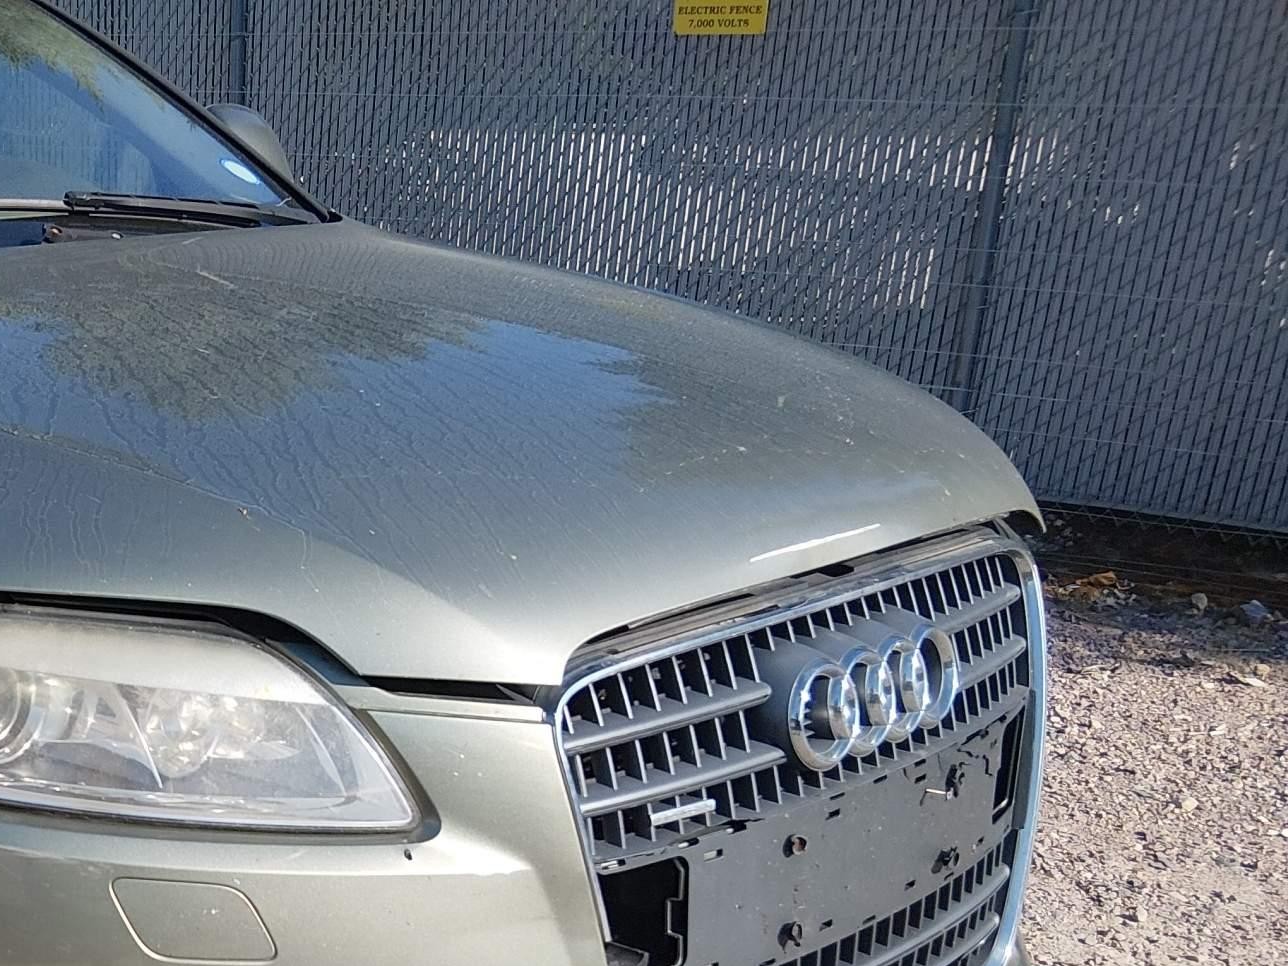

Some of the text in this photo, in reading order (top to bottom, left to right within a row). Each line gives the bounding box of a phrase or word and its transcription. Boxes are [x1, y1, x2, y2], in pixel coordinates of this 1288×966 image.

[678, 5, 762, 15] ELECTRIC FENCE
[688, 19, 750, 28] 7,000 VOLTS
